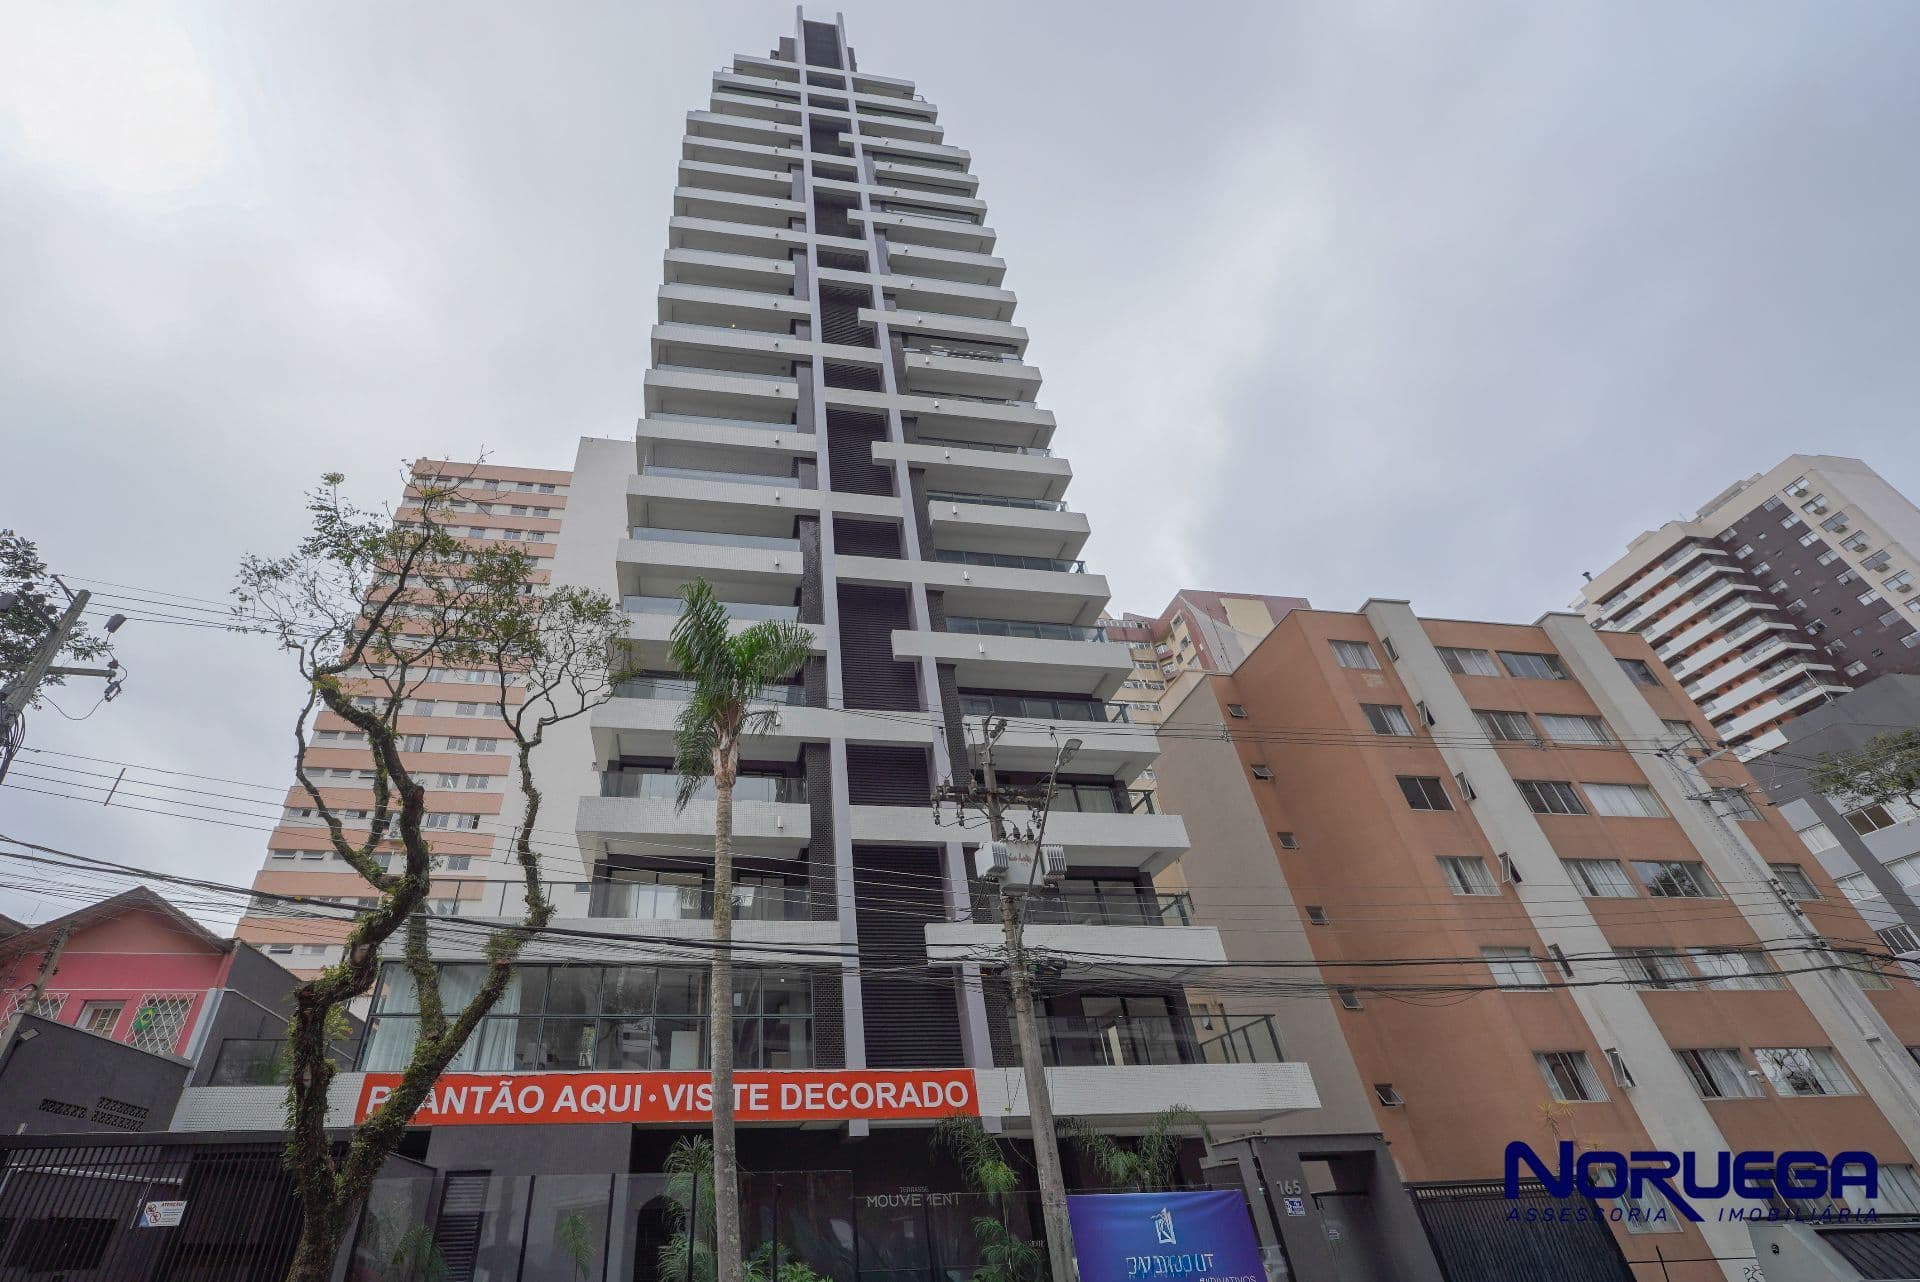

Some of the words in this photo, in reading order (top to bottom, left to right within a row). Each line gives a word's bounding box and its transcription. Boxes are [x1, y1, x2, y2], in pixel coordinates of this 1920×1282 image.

[365, 1080, 546, 1116] PANTÃO
[551, 1084, 643, 1115] AQUI
[661, 1083, 769, 1113] VISTE
[781, 1081, 969, 1110] DECORADO
[1276, 1180, 1302, 1195] 165
